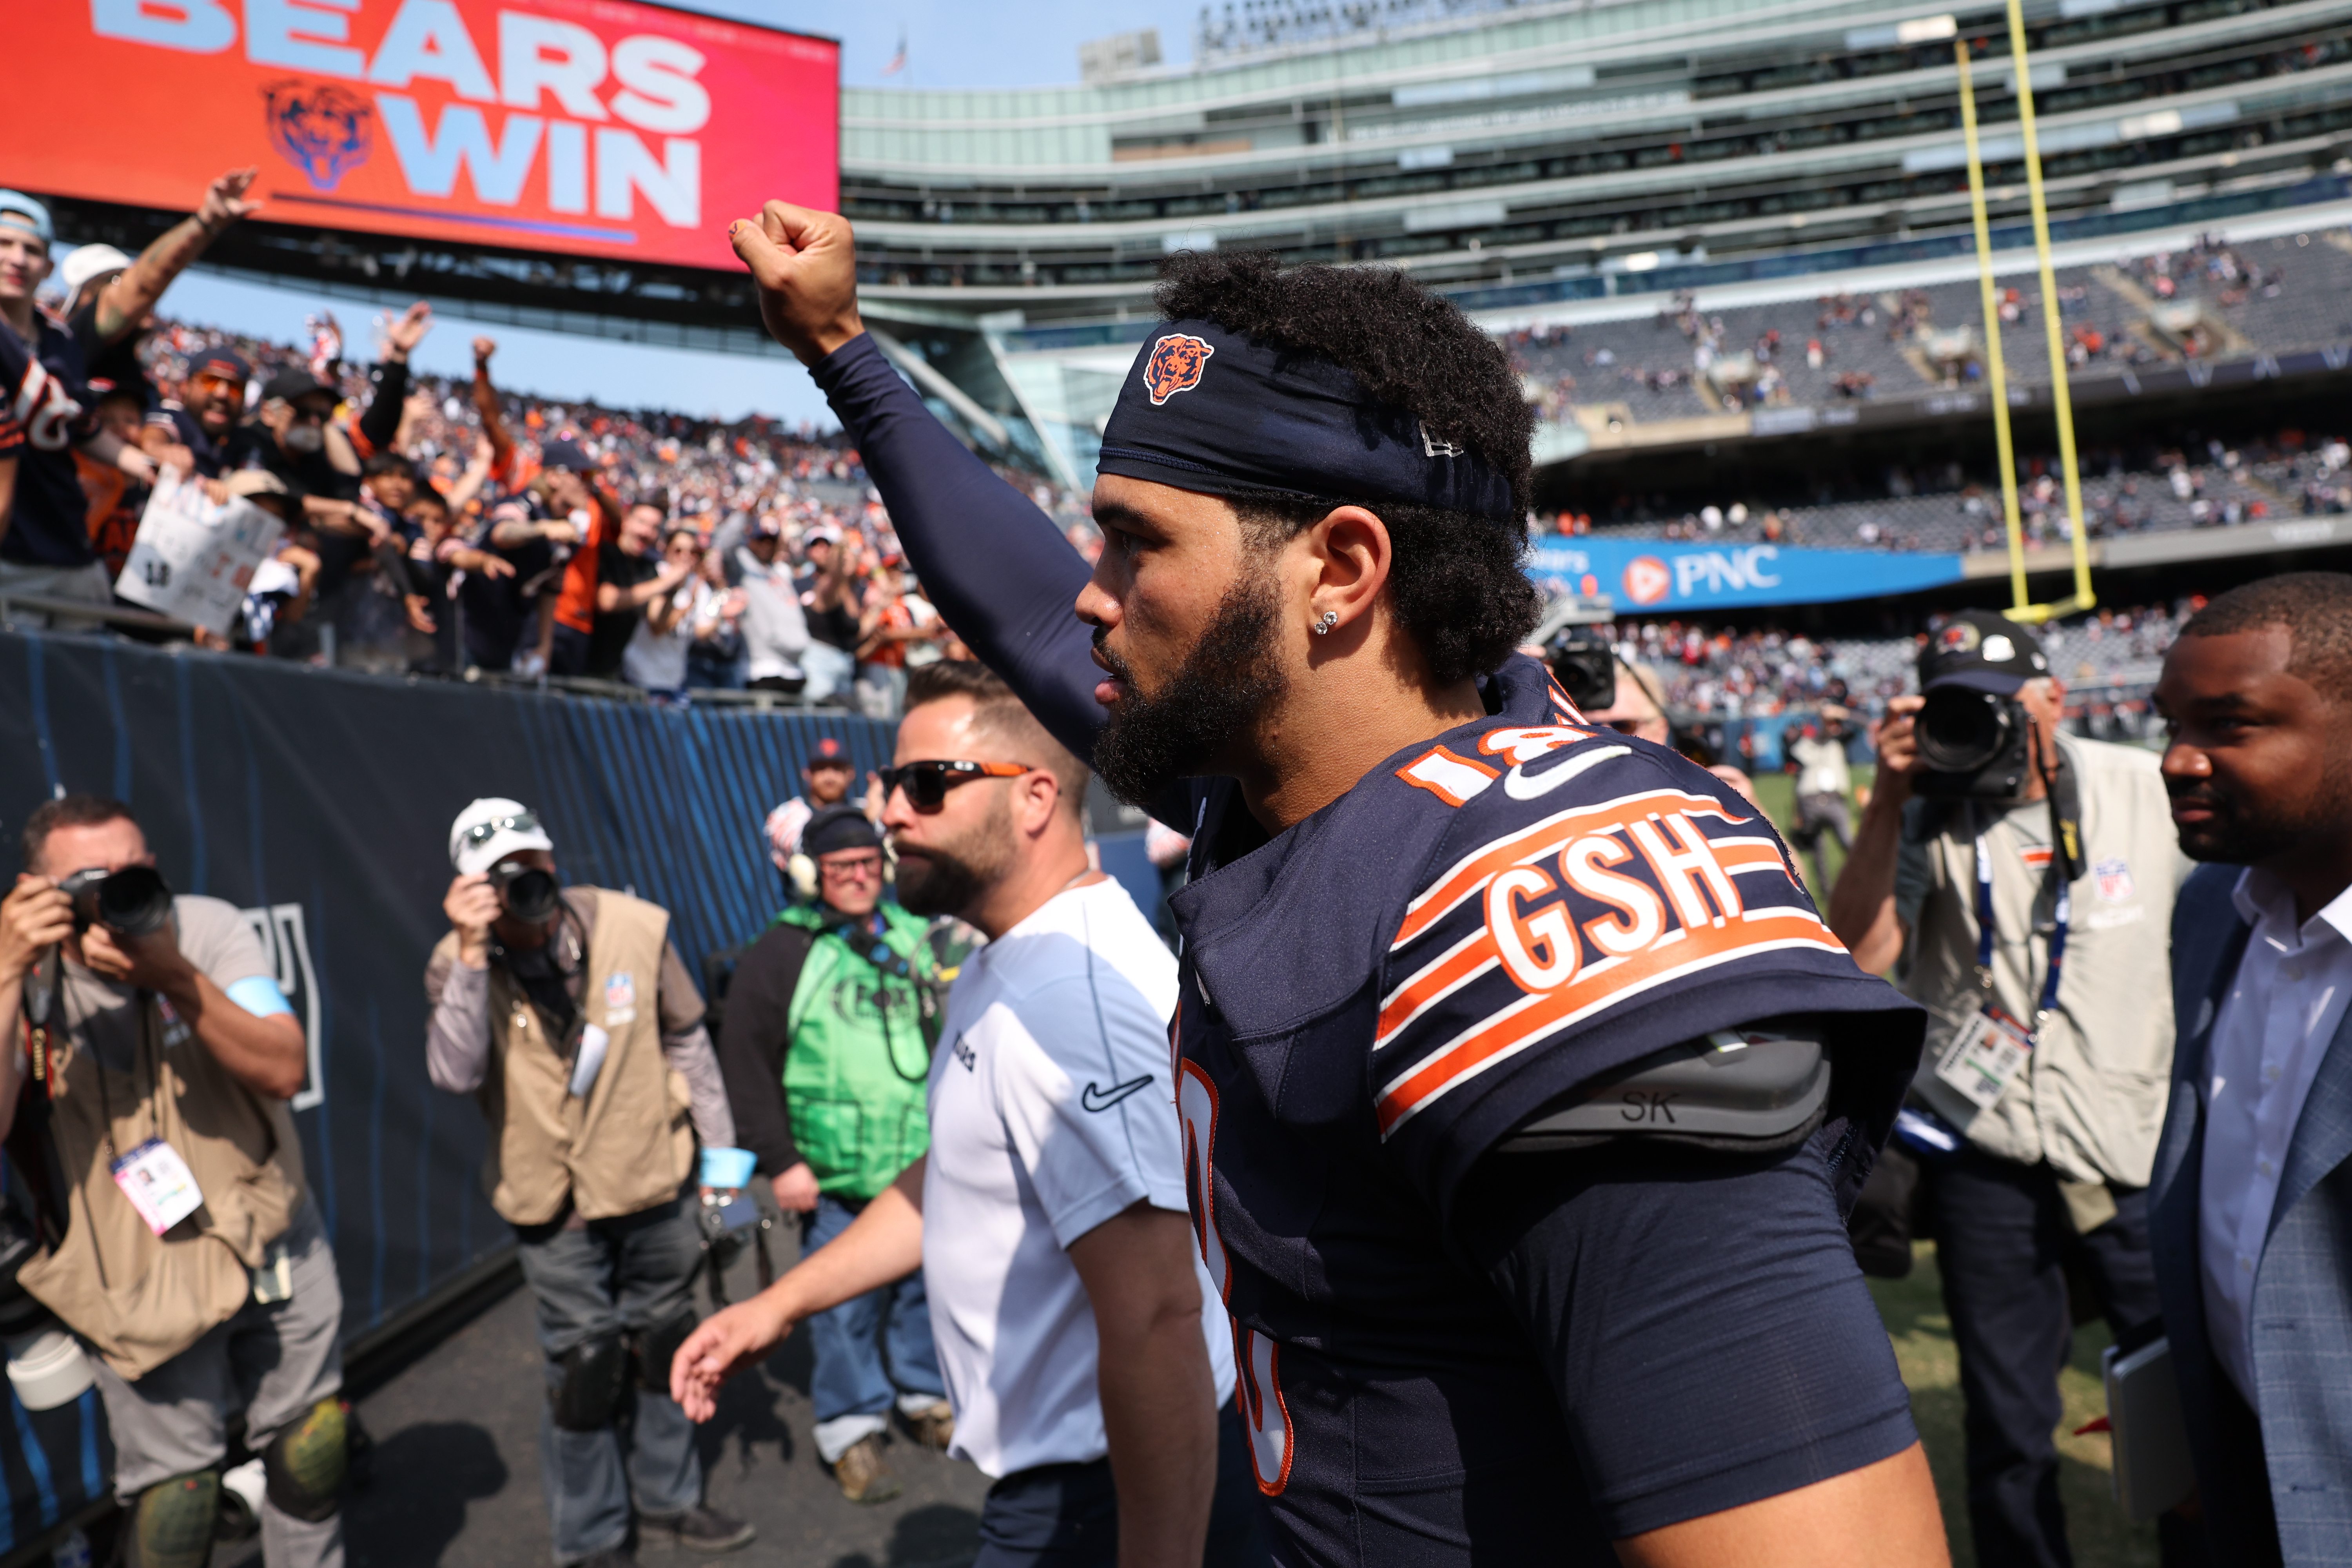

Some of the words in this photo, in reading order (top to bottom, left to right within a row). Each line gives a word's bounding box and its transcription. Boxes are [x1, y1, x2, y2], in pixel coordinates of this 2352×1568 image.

[374, 93, 700, 228] WIN
[1672, 544, 1781, 597] PNC
[1396, 725, 1597, 808] 18
[1484, 811, 1743, 995] GSH
[1620, 1091, 1679, 1124] SK
